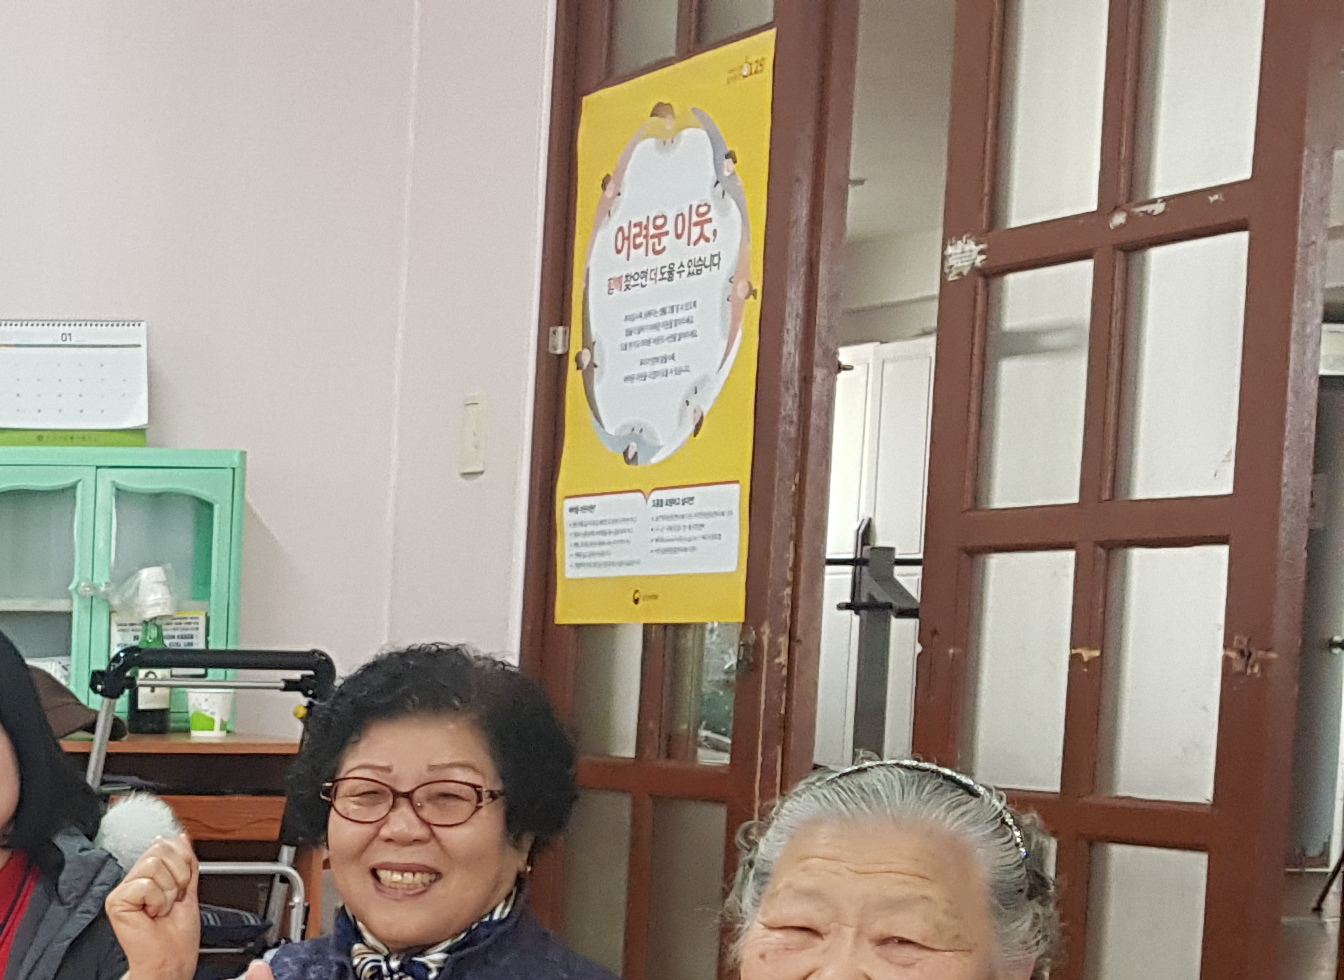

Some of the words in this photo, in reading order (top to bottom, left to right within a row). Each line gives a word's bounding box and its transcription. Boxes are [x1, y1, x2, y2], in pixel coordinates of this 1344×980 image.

[614, 213, 670, 262] 어려운
[674, 203, 718, 246] 이웃,
[624, 268, 648, 292] 찾으면
[658, 262, 676, 282] 도울
[676, 260, 686, 279] 수
[686, 251, 722, 278] 있습니다
[60, 332, 72, 343] 01
